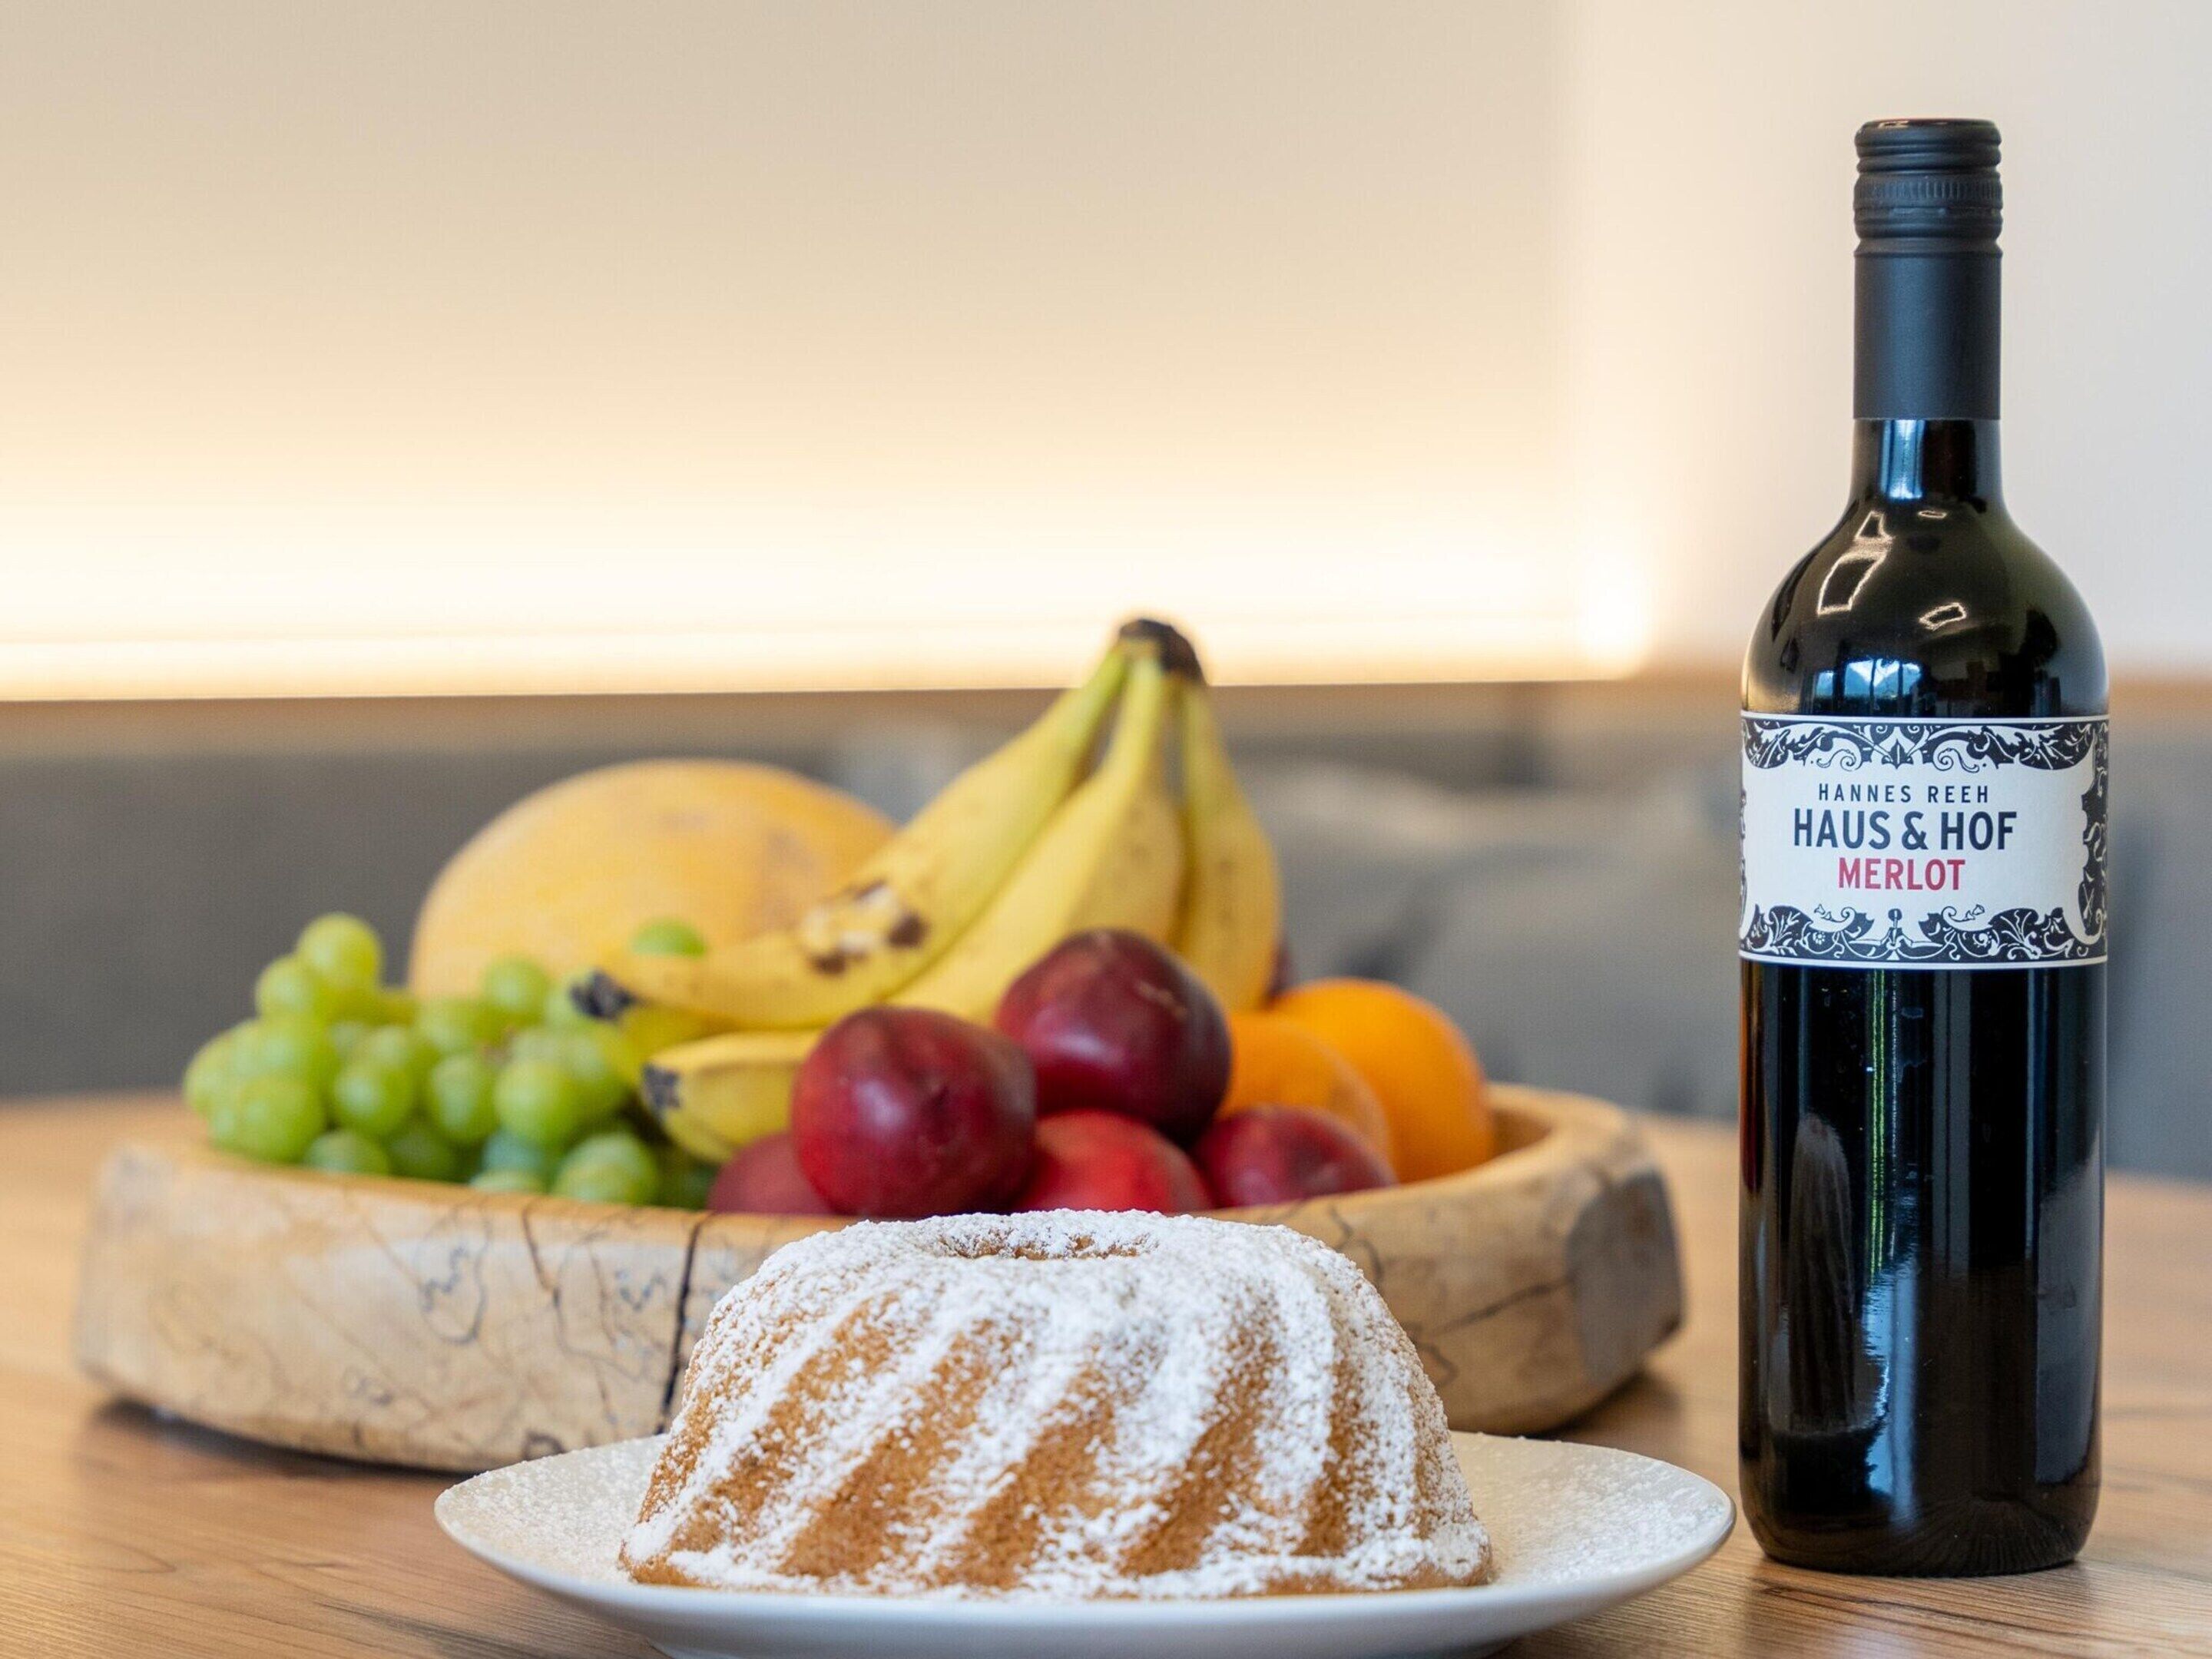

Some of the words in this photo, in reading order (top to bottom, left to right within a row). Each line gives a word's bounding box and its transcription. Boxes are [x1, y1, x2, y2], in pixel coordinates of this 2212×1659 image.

[1818, 783, 1912, 803] HANNES
[1927, 785, 1989, 803] REEH
[1793, 808, 1891, 850] HAUS
[1901, 810, 1929, 851] &
[1940, 810, 2018, 851] HOF
[1838, 857, 1966, 891] MERLOT
